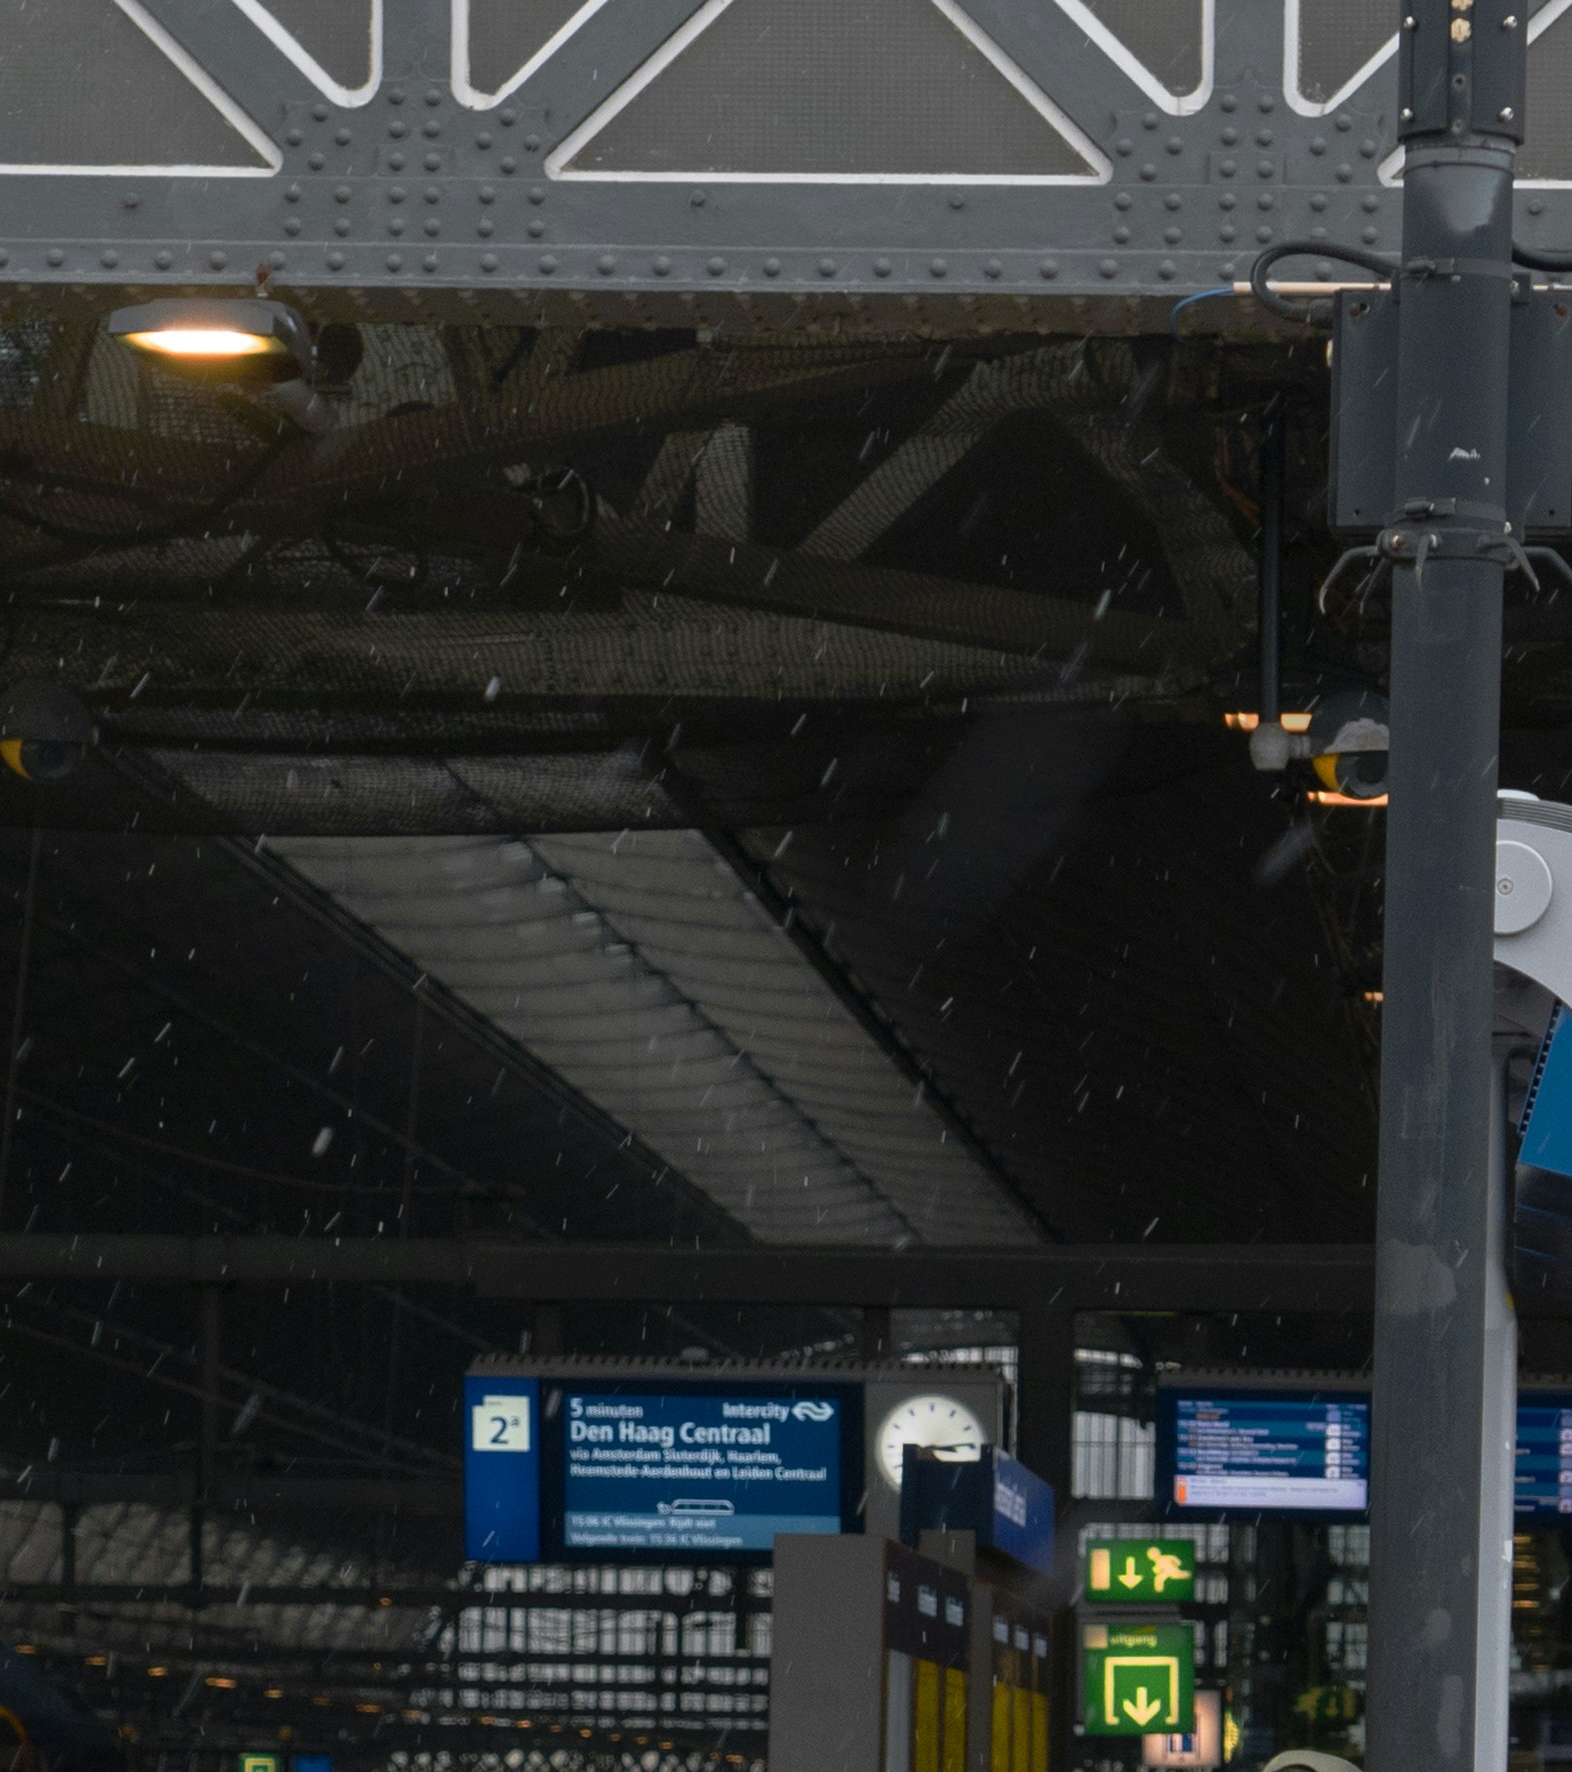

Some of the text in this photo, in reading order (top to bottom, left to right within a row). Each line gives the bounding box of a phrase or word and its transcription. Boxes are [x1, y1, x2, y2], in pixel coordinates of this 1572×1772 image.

[570, 1397, 644, 1418] 5 minuten
[722, 1402, 790, 1422] Intercity
[570, 1420, 771, 1448] Den Haag Centraal
[570, 1447, 590, 1460] via
[591, 1447, 662, 1461] Amsterdam
[714, 1468, 731, 1480] en
[732, 1466, 774, 1480] Leiden
[775, 1466, 827, 1482] Centraal
[1110, 1634, 1158, 1648] uitgang
